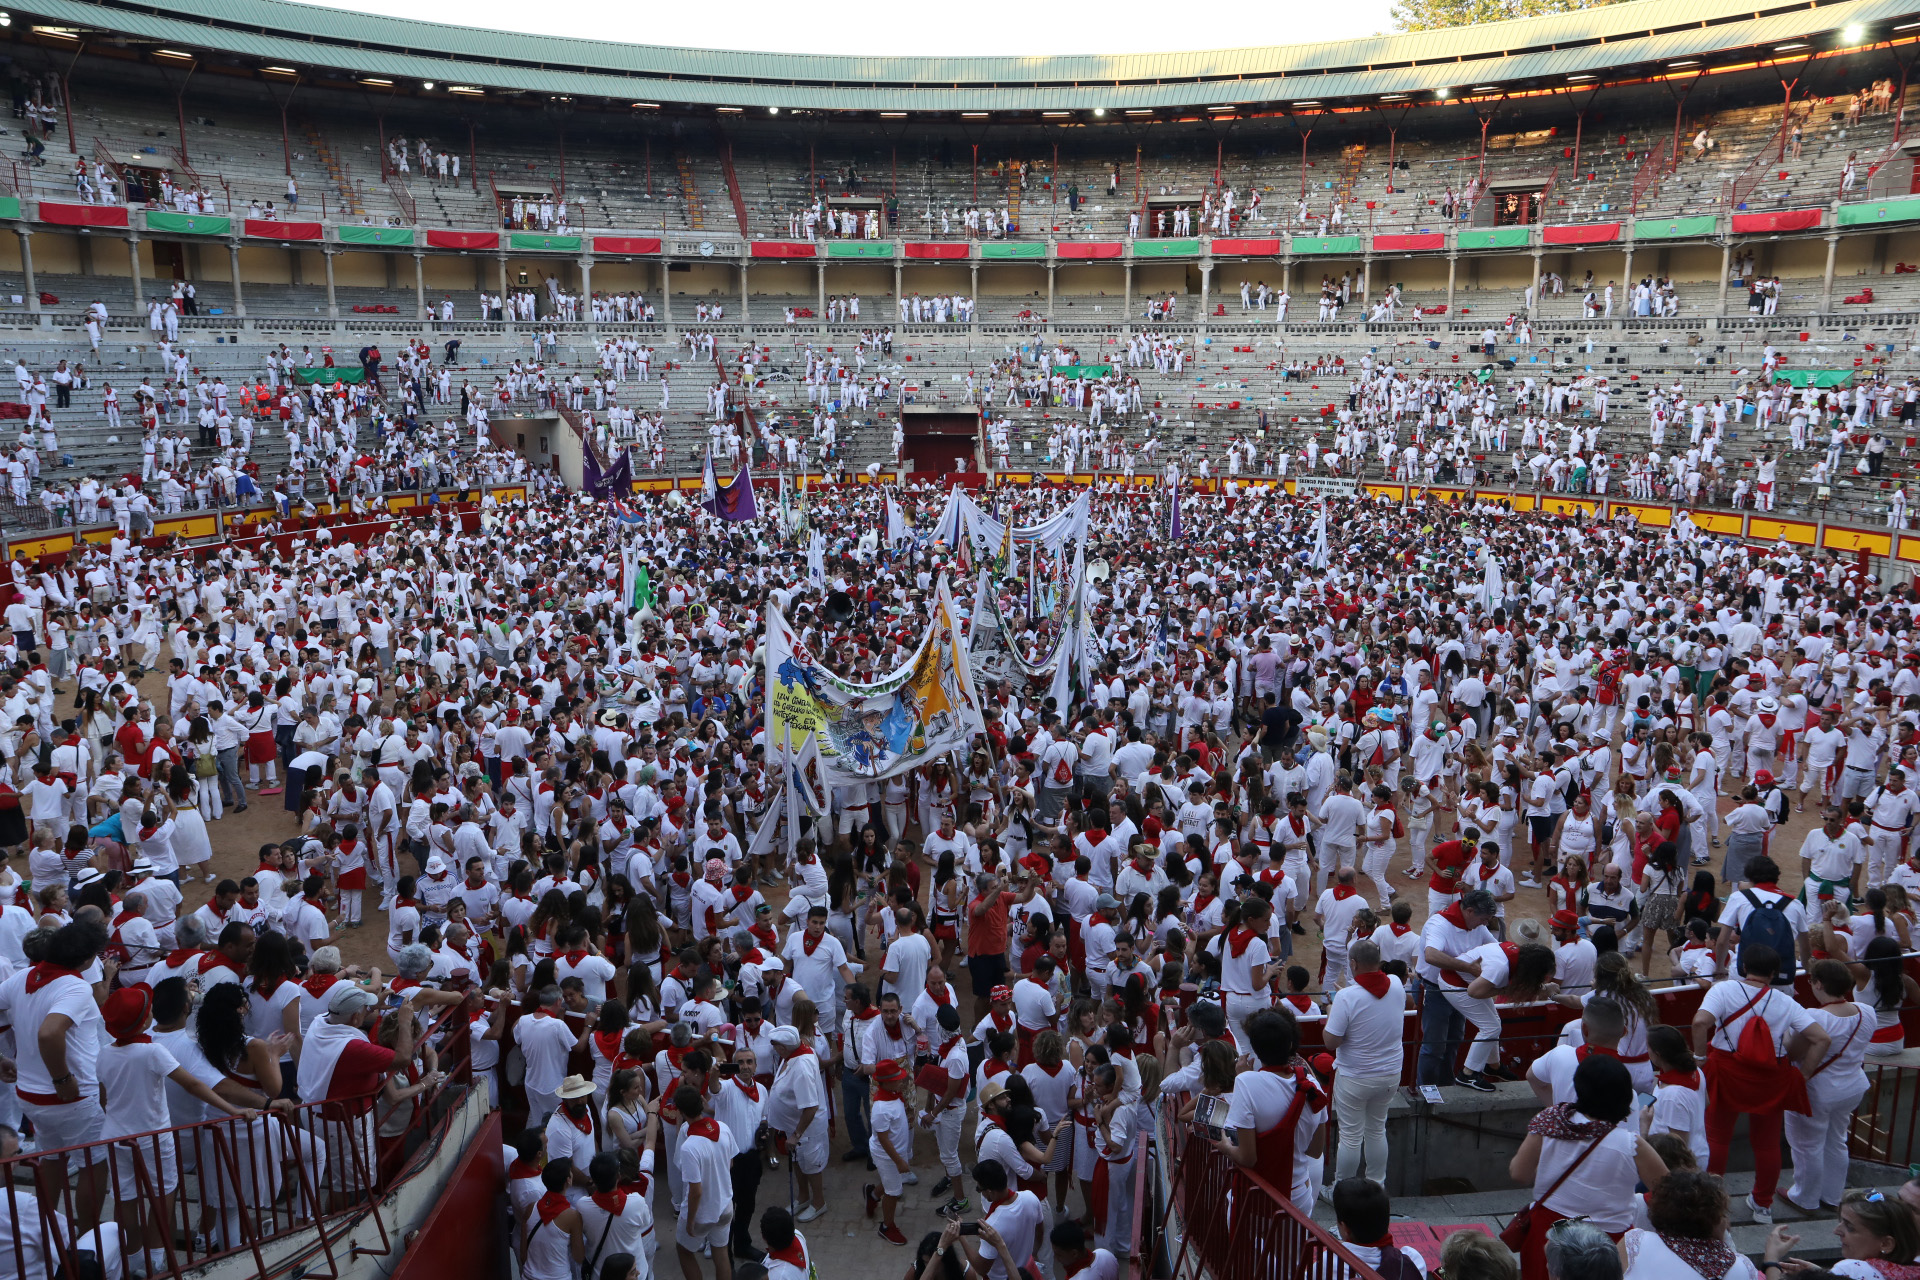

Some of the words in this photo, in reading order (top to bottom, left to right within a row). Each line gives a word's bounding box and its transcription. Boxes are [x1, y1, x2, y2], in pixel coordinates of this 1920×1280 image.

[1372, 488, 1378, 498] 7
[318, 507, 324, 516] 4
[1568, 502, 1575, 512] 7
[251, 514, 258, 523] 4
[1637, 509, 1644, 520] 7
[1707, 516, 1714, 527] 7
[182, 523, 190, 534] 4
[1779, 525, 1787, 534] 7
[1853, 534, 1860, 546] 7
[39, 543, 48, 555] 3
[804, 718, 816, 726] ETA
